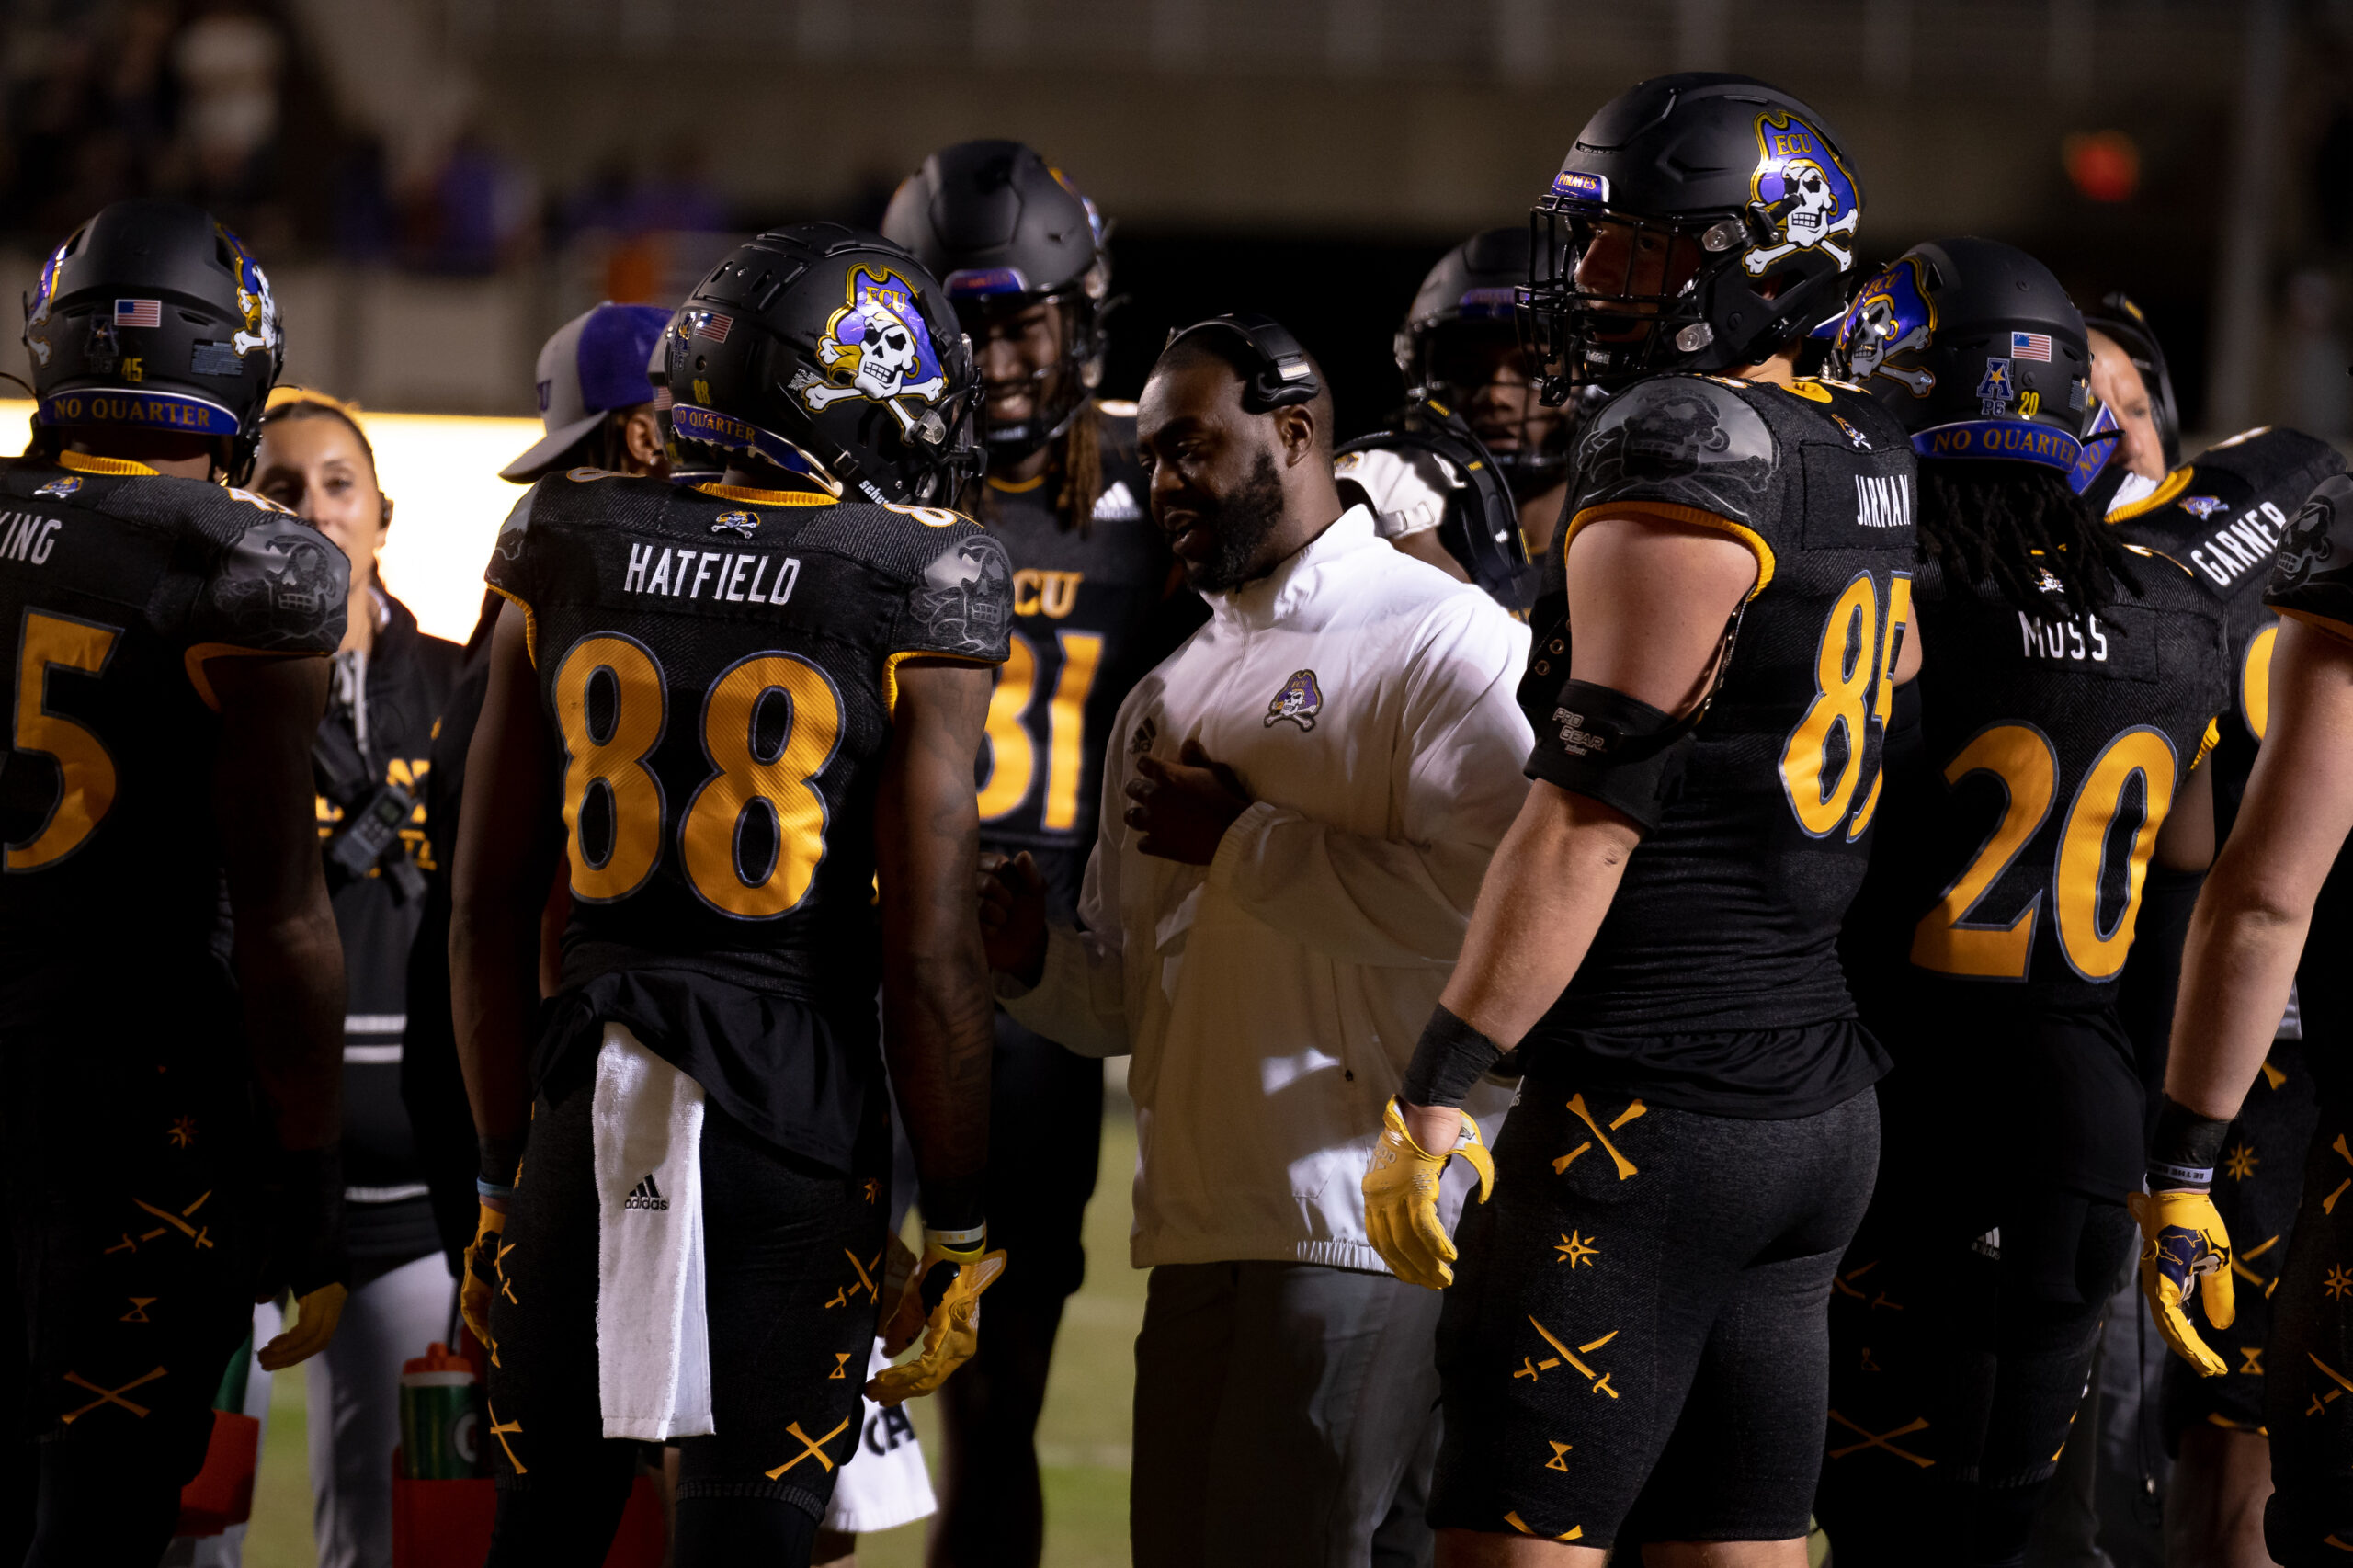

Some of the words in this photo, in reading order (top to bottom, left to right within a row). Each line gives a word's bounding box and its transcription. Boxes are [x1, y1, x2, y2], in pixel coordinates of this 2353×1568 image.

[1773, 133, 1813, 156] ECU
[1558, 173, 1597, 190] PIRATES
[864, 286, 907, 313] ECU
[120, 357, 143, 382] 45
[693, 378, 711, 405] 88
[2018, 391, 2040, 417] 20
[54, 398, 82, 420] NO
[91, 398, 210, 427] QUARTER
[1981, 398, 2006, 415] P6
[689, 412, 756, 445] QUARTER
[1933, 429, 1972, 453] NO
[1983, 427, 2077, 467] QUARTER
[1855, 473, 1912, 528] JARMAN
[623, 542, 801, 606] HATFIELD
[1012, 568, 1084, 619] CU
[1552, 707, 1585, 729] PRO
[1559, 724, 1606, 752] GEAR
[552, 631, 846, 921] 88
[1909, 717, 2179, 984] 20
[624, 1197, 668, 1210] adidas
